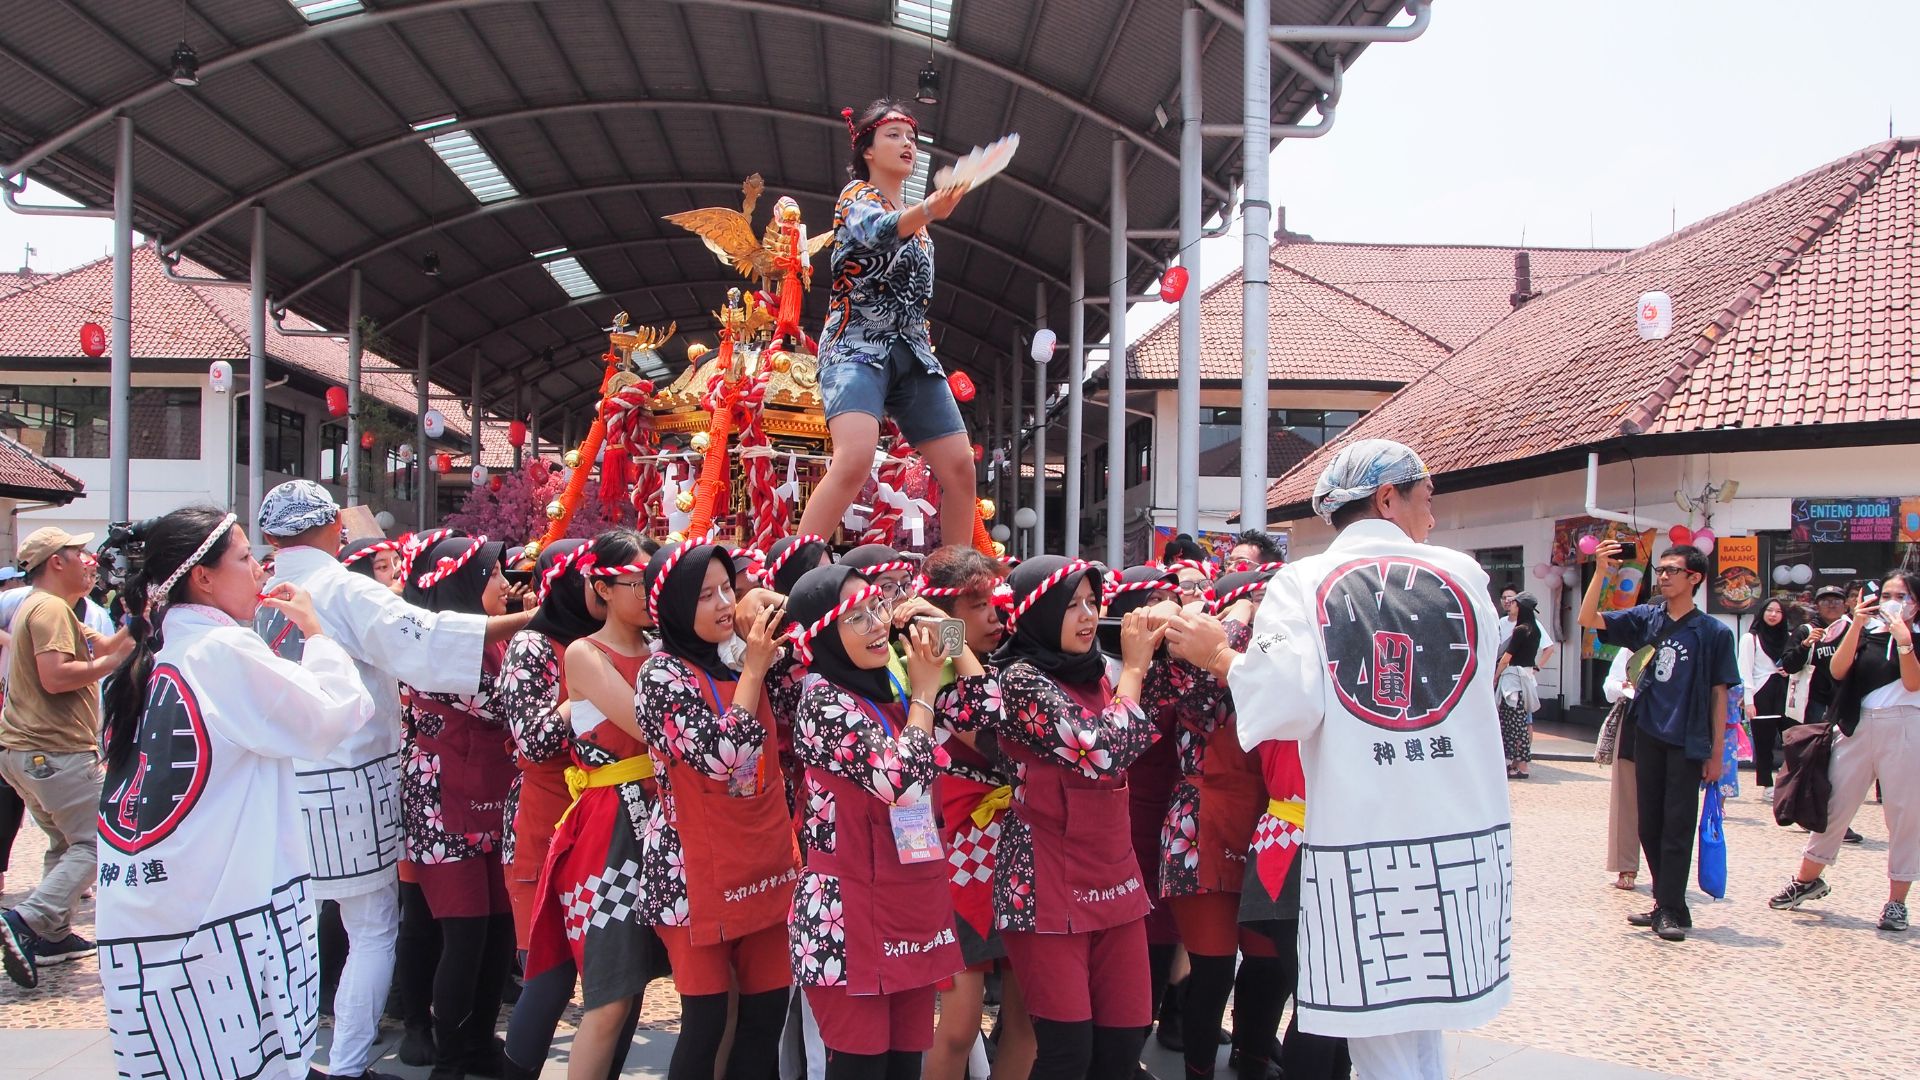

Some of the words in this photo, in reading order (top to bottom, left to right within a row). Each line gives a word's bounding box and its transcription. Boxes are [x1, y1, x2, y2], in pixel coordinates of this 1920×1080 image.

[1810, 504, 1853, 518] ENTENG
[1855, 503, 1890, 518] JODOH
[1723, 545, 1752, 553] BAKSO
